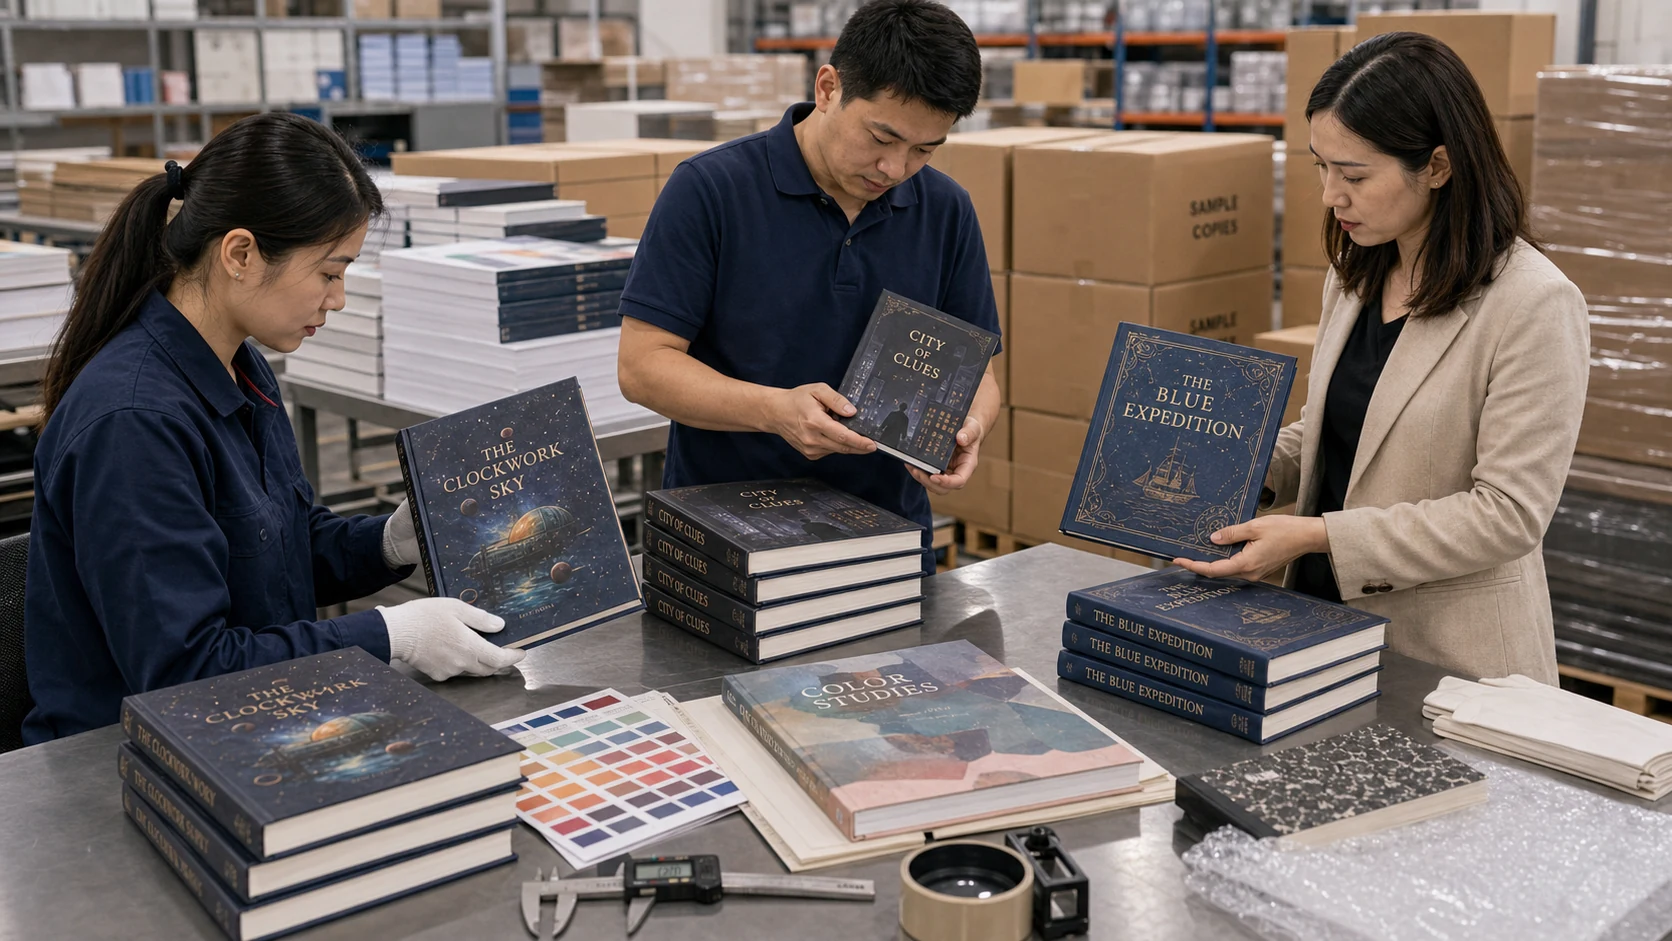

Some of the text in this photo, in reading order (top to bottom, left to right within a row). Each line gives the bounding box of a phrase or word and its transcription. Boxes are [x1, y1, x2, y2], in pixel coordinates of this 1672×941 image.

[1189, 194, 1238, 217] SAMPLE
[1191, 218, 1239, 240] COPIES
[1189, 311, 1238, 335] SAMPLE
[909, 329, 946, 351] CITY
[893, 352, 941, 380] CLUES
[914, 347, 931, 360] OF
[1182, 374, 1213, 391] THE
[1156, 386, 1214, 412] BLUE
[1122, 402, 1245, 440] EXPEDITION
[481, 440, 516, 461] THE
[443, 441, 564, 493] CLOCKWORK
[489, 474, 526, 500] SKY
[740, 489, 777, 497] CITY
[749, 499, 803, 509] CLUES
[658, 509, 706, 546] CITY OF CLUES
[657, 539, 675, 557] CITY
[674, 548, 684, 562] OF
[684, 553, 708, 575] CLUES
[657, 570, 708, 608] CITY OF CLUES
[657, 600, 675, 618] CITY
[675, 609, 685, 622] OF
[686, 613, 710, 635] CLUES
[1093, 609, 1213, 660] THE BLUE EXPEDITION
[1090, 637, 1209, 687] THE BLUE EXPEDITION
[246, 684, 294, 701] THE
[801, 673, 913, 698] COLOR
[813, 681, 939, 710] STUDIES
[1085, 666, 1204, 716] THE BLUE EXPEDITION
[273, 700, 320, 720] SKY
